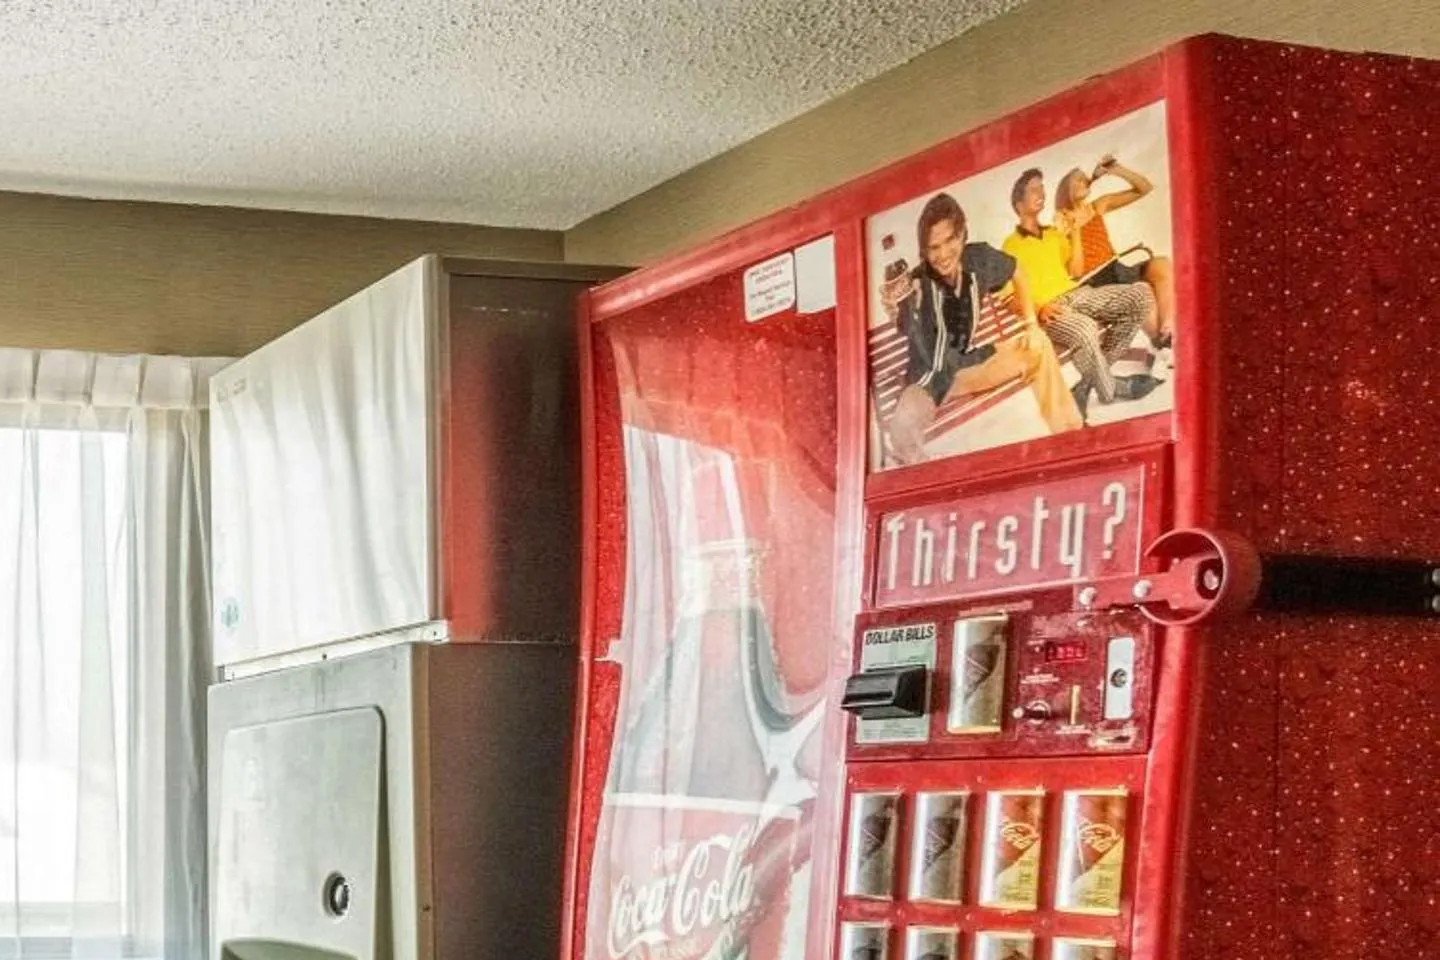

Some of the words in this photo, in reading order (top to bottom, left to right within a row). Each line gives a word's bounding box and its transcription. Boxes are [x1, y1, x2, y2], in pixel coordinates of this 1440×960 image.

[886, 482, 1127, 590] Thirsty?
[865, 629, 903, 645] DOLLAR
[906, 625, 934, 641] BILLS
